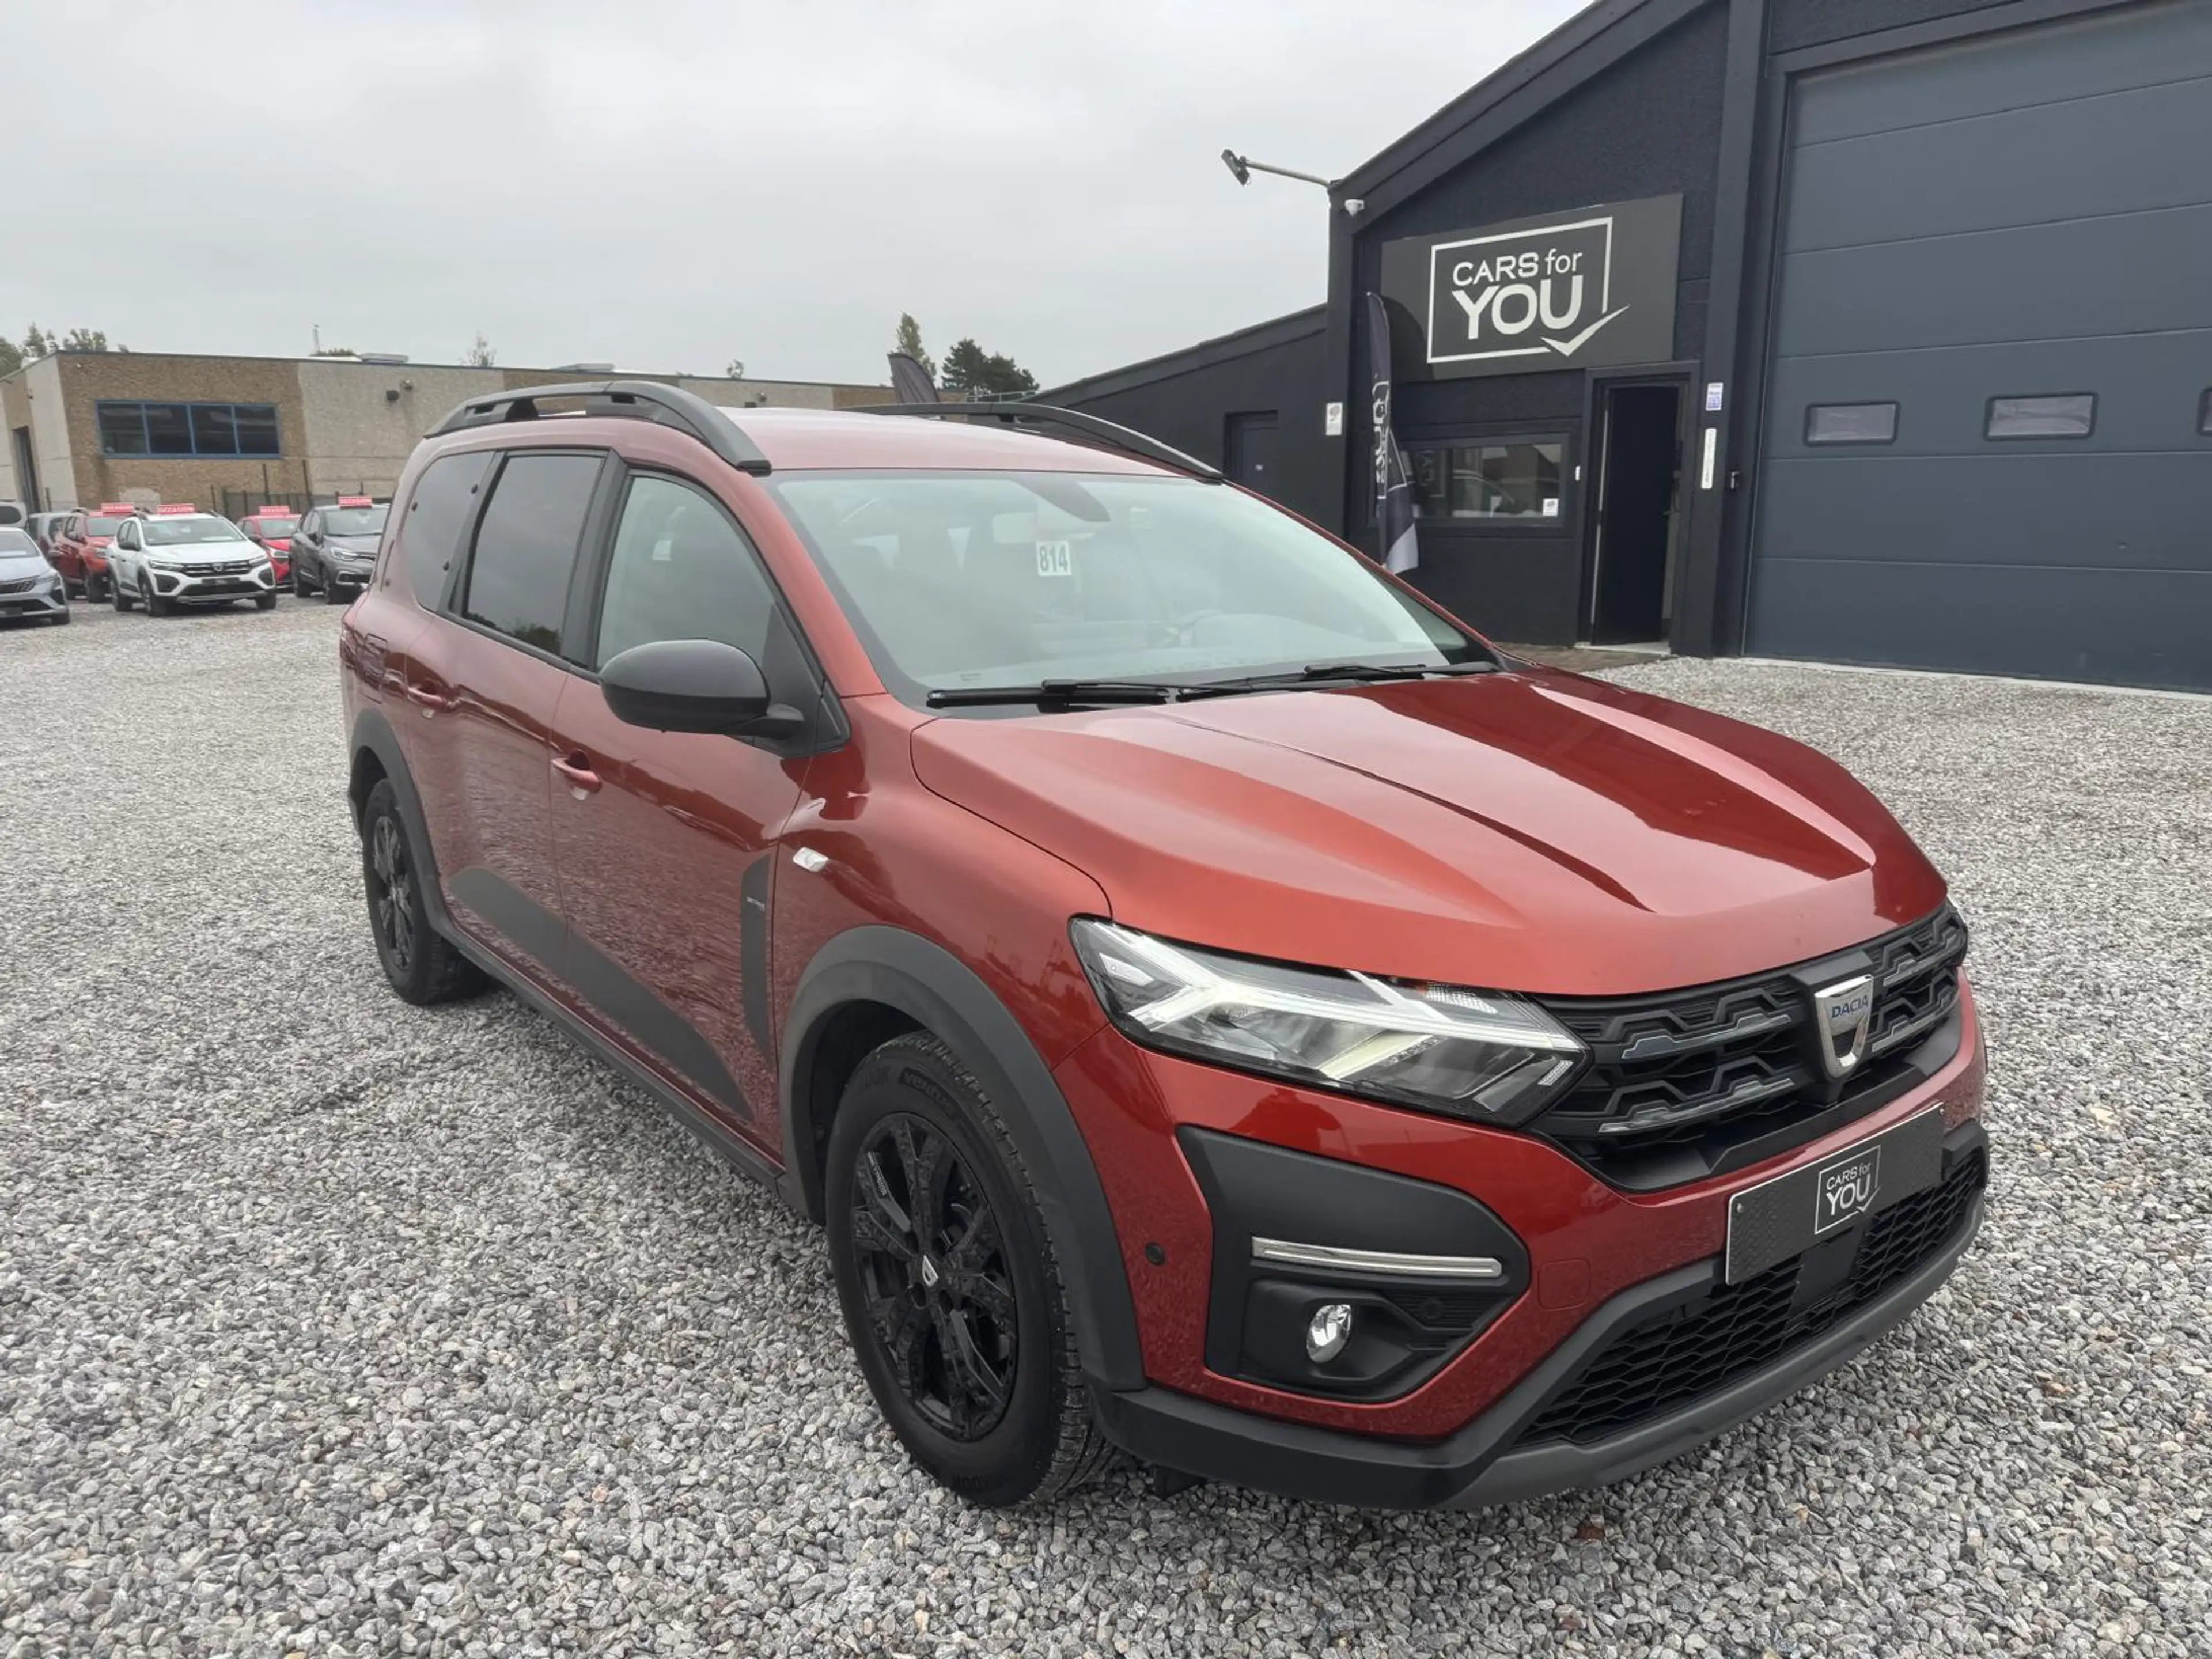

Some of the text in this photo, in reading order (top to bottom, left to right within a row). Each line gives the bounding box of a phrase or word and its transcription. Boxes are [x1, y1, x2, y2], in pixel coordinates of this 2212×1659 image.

[1452, 248, 1583, 286] CARS for
[1452, 275, 1584, 340] YOU
[1039, 544, 1068, 572] 814
[1831, 995, 1868, 1018] DACIA
[1826, 1161, 1872, 1190] CARS for
[1825, 1173, 1871, 1216] YOU
